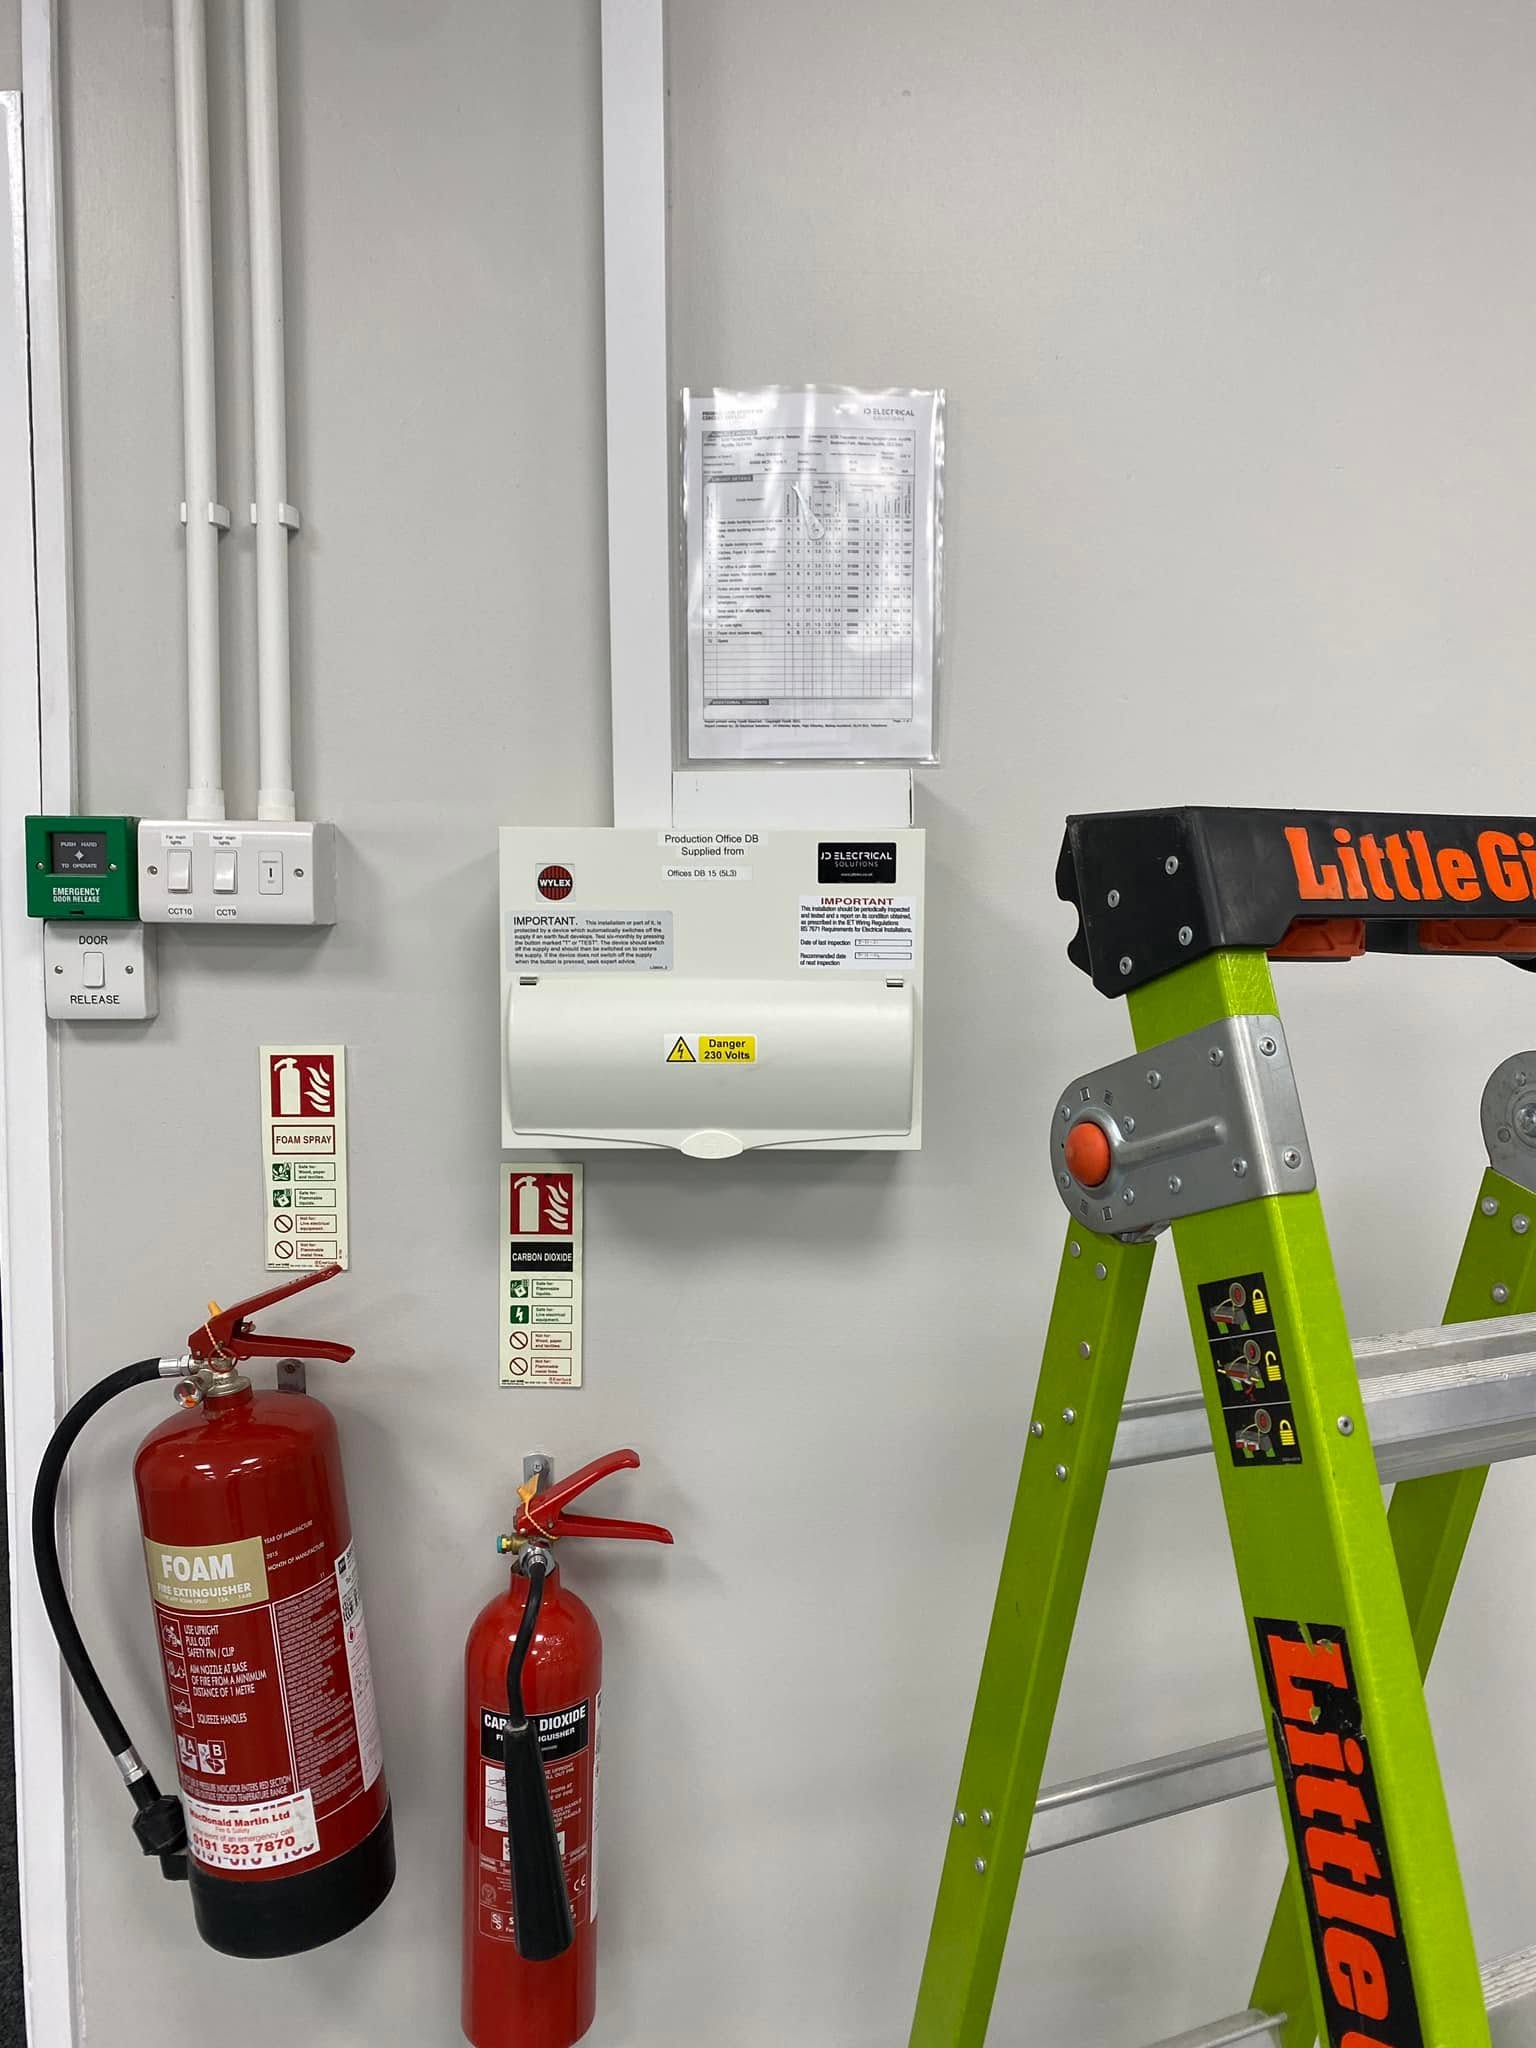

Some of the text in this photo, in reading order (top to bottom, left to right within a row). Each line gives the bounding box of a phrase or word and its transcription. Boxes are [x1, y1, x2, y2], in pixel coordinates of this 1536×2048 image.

[664, 835, 759, 844] Production Office DB
[681, 847, 744, 856] Supplied from
[820, 852, 892, 860] JD ELECTRICAL
[719, 870, 737, 878] (5L3)
[514, 916, 578, 925] IMPORTANT.
[78, 936, 108, 945] DOOR
[70, 995, 120, 1005] RELEASE
[709, 1040, 746, 1049] Danger
[704, 1051, 750, 1060] 230 Volts
[276, 1136, 332, 1144] FOAM SPRAY
[512, 1253, 572, 1261] CARBON DIOXIDE
[264, 1536, 275, 1544] YEAR
[283, 1520, 313, 1538] MANUFACTURE
[268, 1560, 286, 1572] MONTH
[295, 1541, 325, 1561] MANUFACTURE
[160, 1554, 234, 1582] FOAM
[157, 1582, 252, 1598] FIRE EXTINGUISHER
[184, 1625, 219, 1635] USE UPRIGHT
[186, 1636, 210, 1647] PULL OUT
[187, 1648, 205, 1657] SAFETY
[206, 1648, 216, 1658] PIN
[222, 1647, 234, 1657] CLIP
[200, 1665, 222, 1674] NOZZLE
[224, 1664, 231, 1673] AT
[232, 1662, 248, 1673] BASE
[191, 1670, 267, 1686] OF FIRE FROM A MINIMUM
[193, 1687, 219, 1697] DISTANCE
[220, 1687, 229, 1697] OF
[235, 1684, 255, 1696] METRE
[197, 1713, 247, 1724] SQUEEZE HANDLES
[540, 1705, 586, 1731] DIOXIDE
[187, 1742, 194, 1752] A
[213, 1744, 222, 1755] B
[270, 1776, 292, 1788] SECTION
[270, 1785, 288, 1796] RANGE
[235, 1816, 269, 1827] Martin
[272, 1811, 290, 1821] Ltd
[1267, 1634, 1388, 2020] Little
[238, 1832, 278, 1842] emergency
[280, 1827, 294, 1836] call
[222, 1844, 249, 1855] 523
[255, 1836, 295, 1853] 7870
